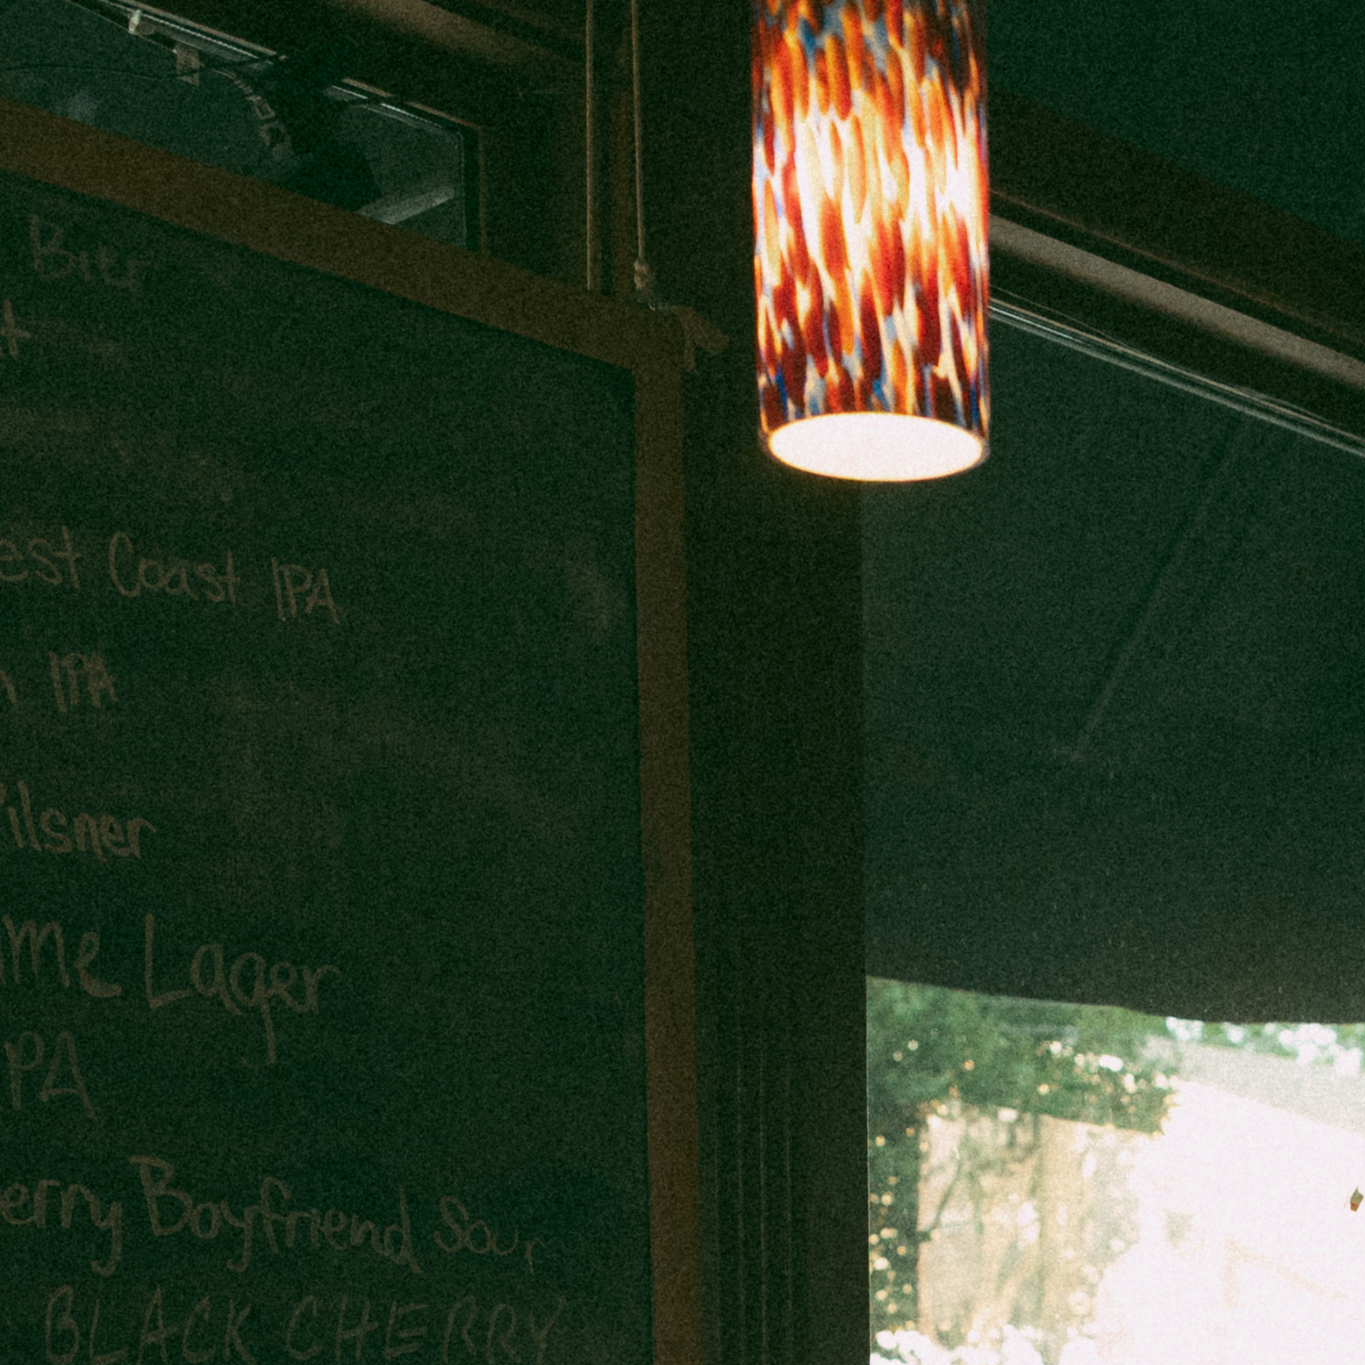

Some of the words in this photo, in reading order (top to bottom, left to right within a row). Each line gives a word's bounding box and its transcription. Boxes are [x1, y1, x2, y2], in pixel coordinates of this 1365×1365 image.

[107, 531, 240, 603] Coast
[270, 556, 342, 624] IPA
[48, 650, 118, 713] IPA
[144, 915, 343, 1070] Lager
[129, 1156, 422, 1274] Boyfriend
[433, 1196, 546, 1274] Sour
